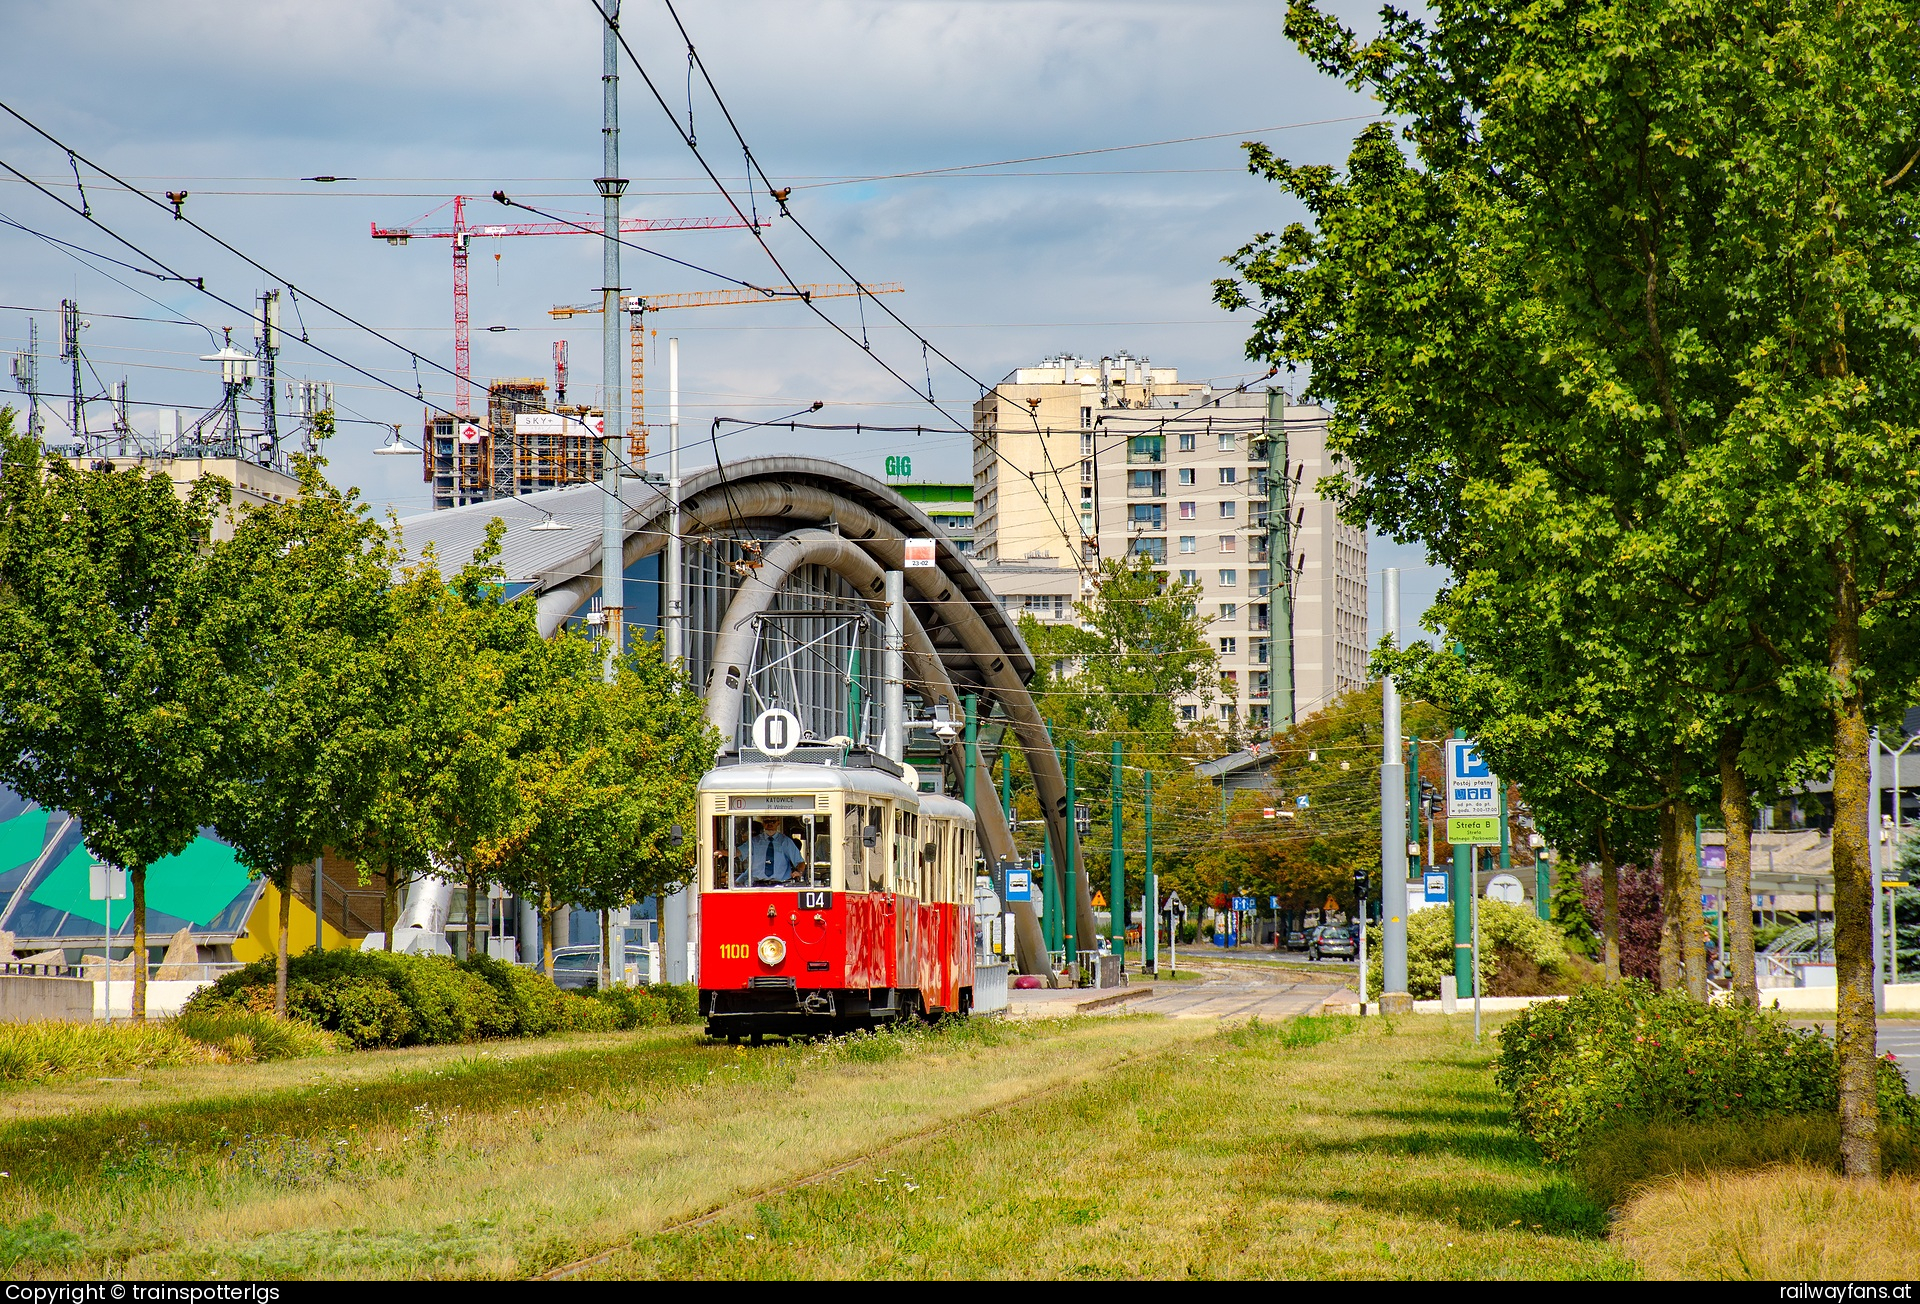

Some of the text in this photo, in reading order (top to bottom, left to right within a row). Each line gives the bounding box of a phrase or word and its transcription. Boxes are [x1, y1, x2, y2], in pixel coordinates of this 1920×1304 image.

[525, 417, 553, 425] SKY+
[885, 455, 912, 476] GIG
[1463, 748, 1482, 774] P
[1453, 779, 1471, 787] Postój
[1456, 821, 1481, 829] Strefa
[806, 892, 824, 908] 04
[719, 944, 749, 959] 1100
